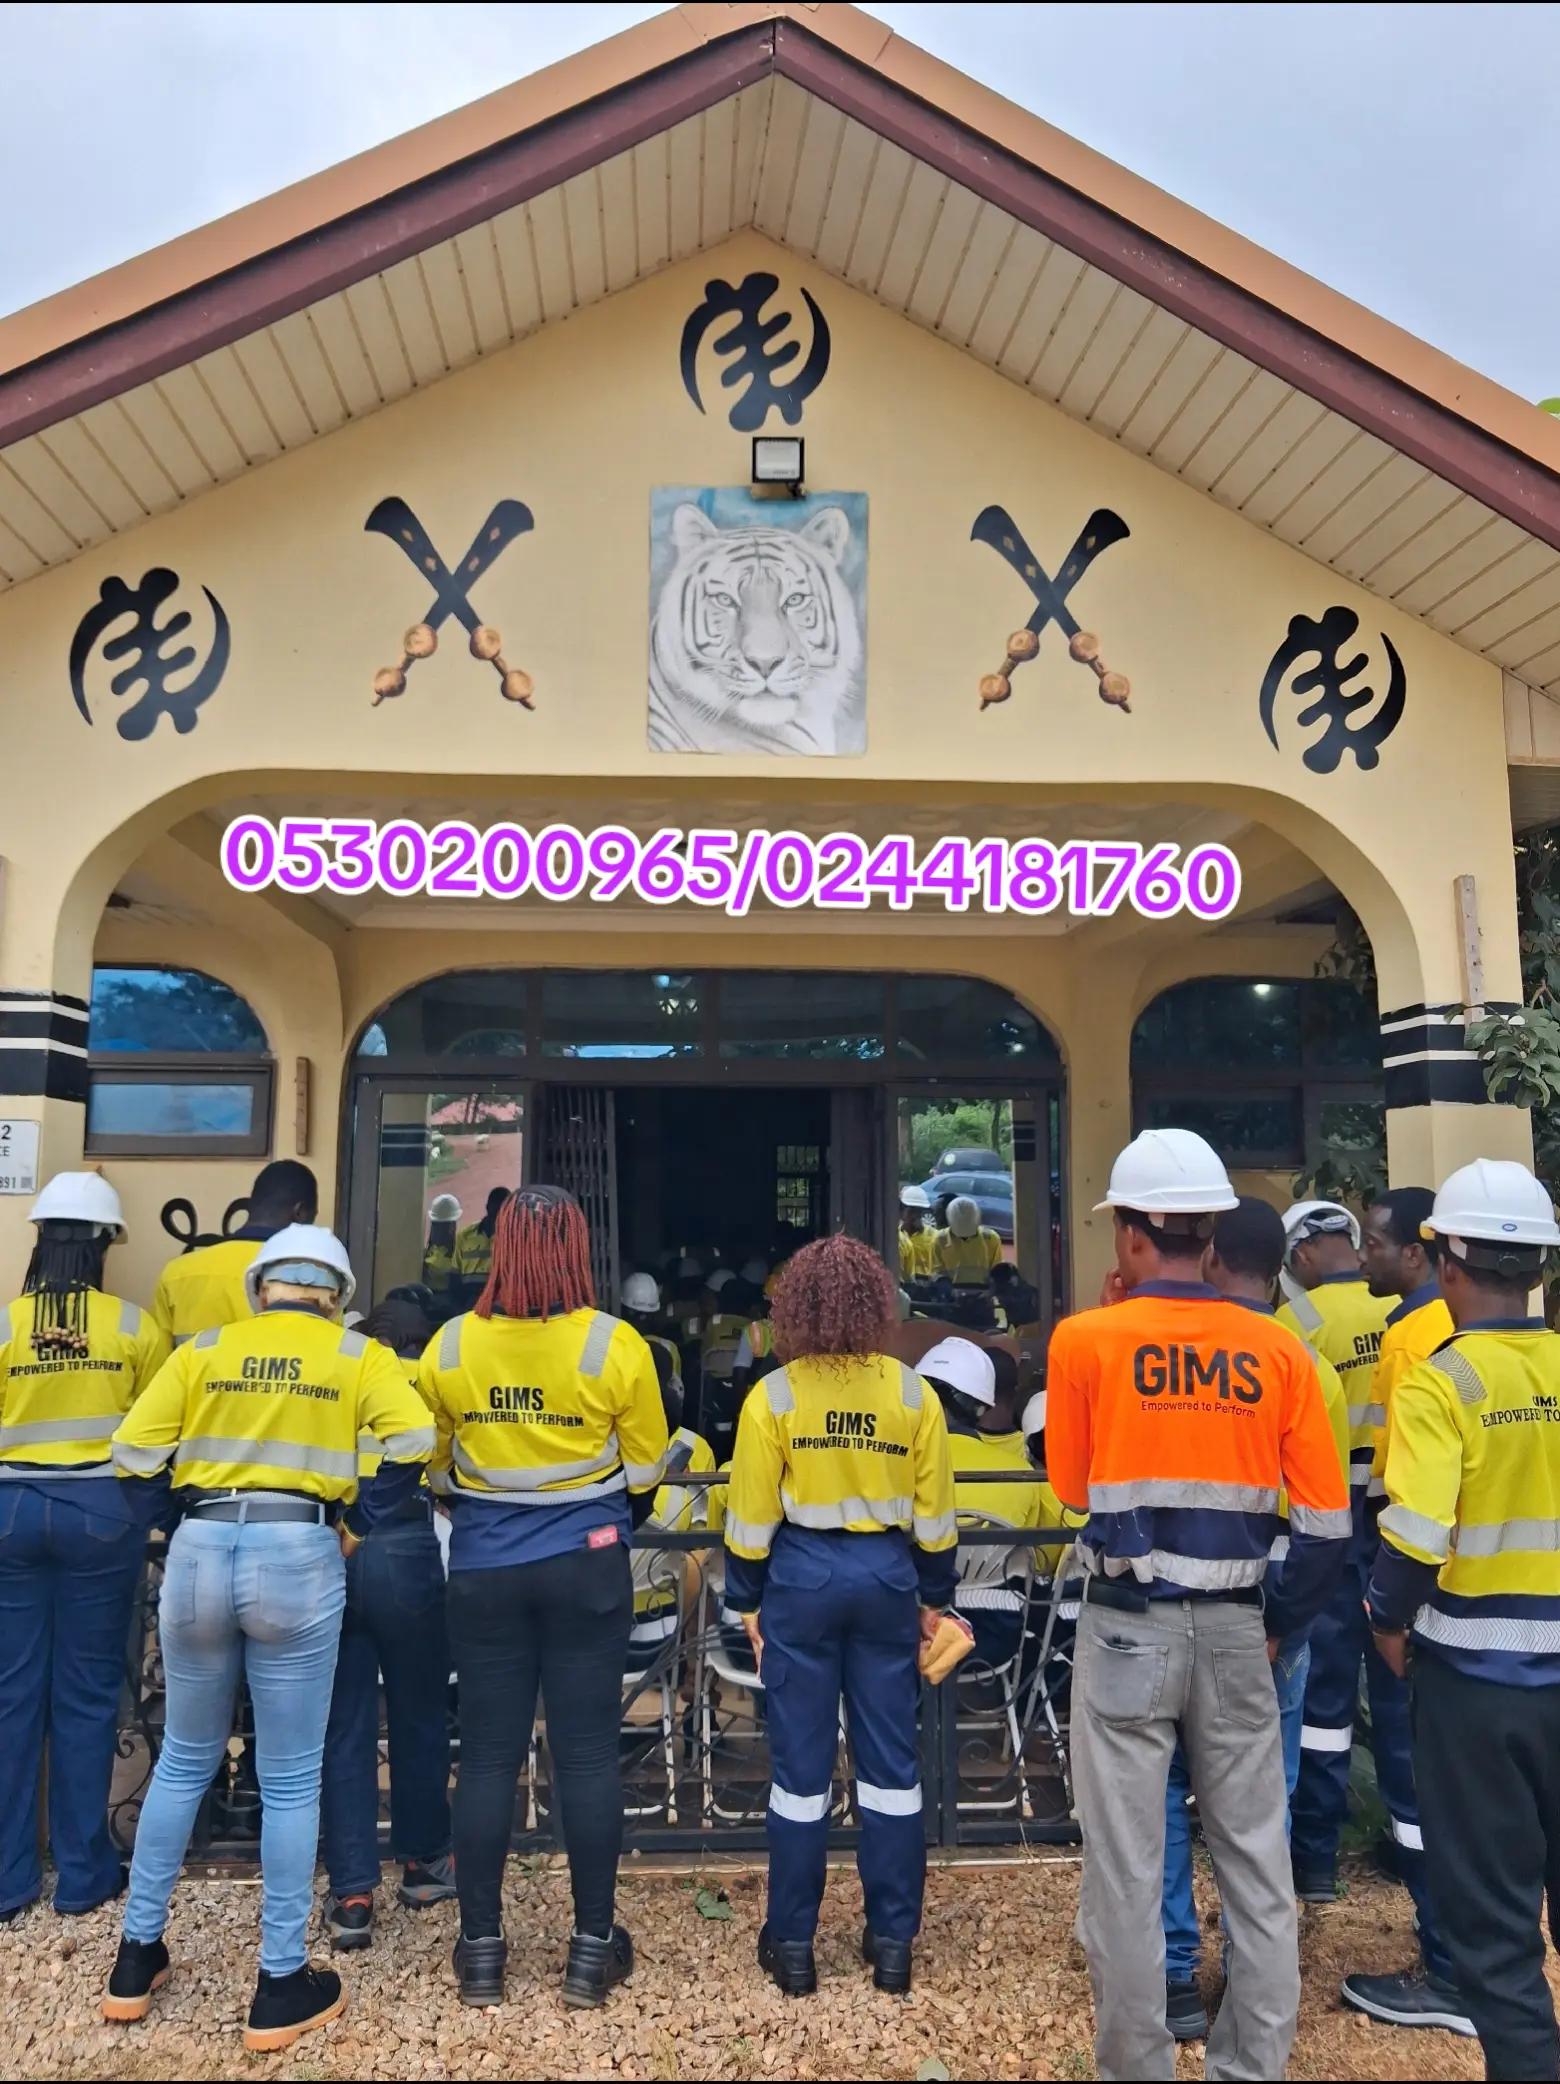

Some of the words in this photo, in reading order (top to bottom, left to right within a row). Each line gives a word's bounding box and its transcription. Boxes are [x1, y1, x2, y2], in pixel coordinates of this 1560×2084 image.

[1353, 1330, 1385, 1355] GIM
[67, 1361, 80, 1371] TO
[241, 1356, 303, 1381] GIMS
[1133, 1343, 1264, 1404] GIMS
[289, 1382, 340, 1402] PERFORM
[489, 1386, 544, 1411] GIMS
[521, 1412, 534, 1424] TO
[536, 1412, 584, 1427] PERFORM
[1141, 1400, 1199, 1412] Empowered
[1201, 1402, 1212, 1411] to
[1214, 1402, 1256, 1418] Perform
[826, 1410, 877, 1437] GIMS
[792, 1436, 850, 1449] EMPOWERED
[852, 1437, 864, 1450] TO
